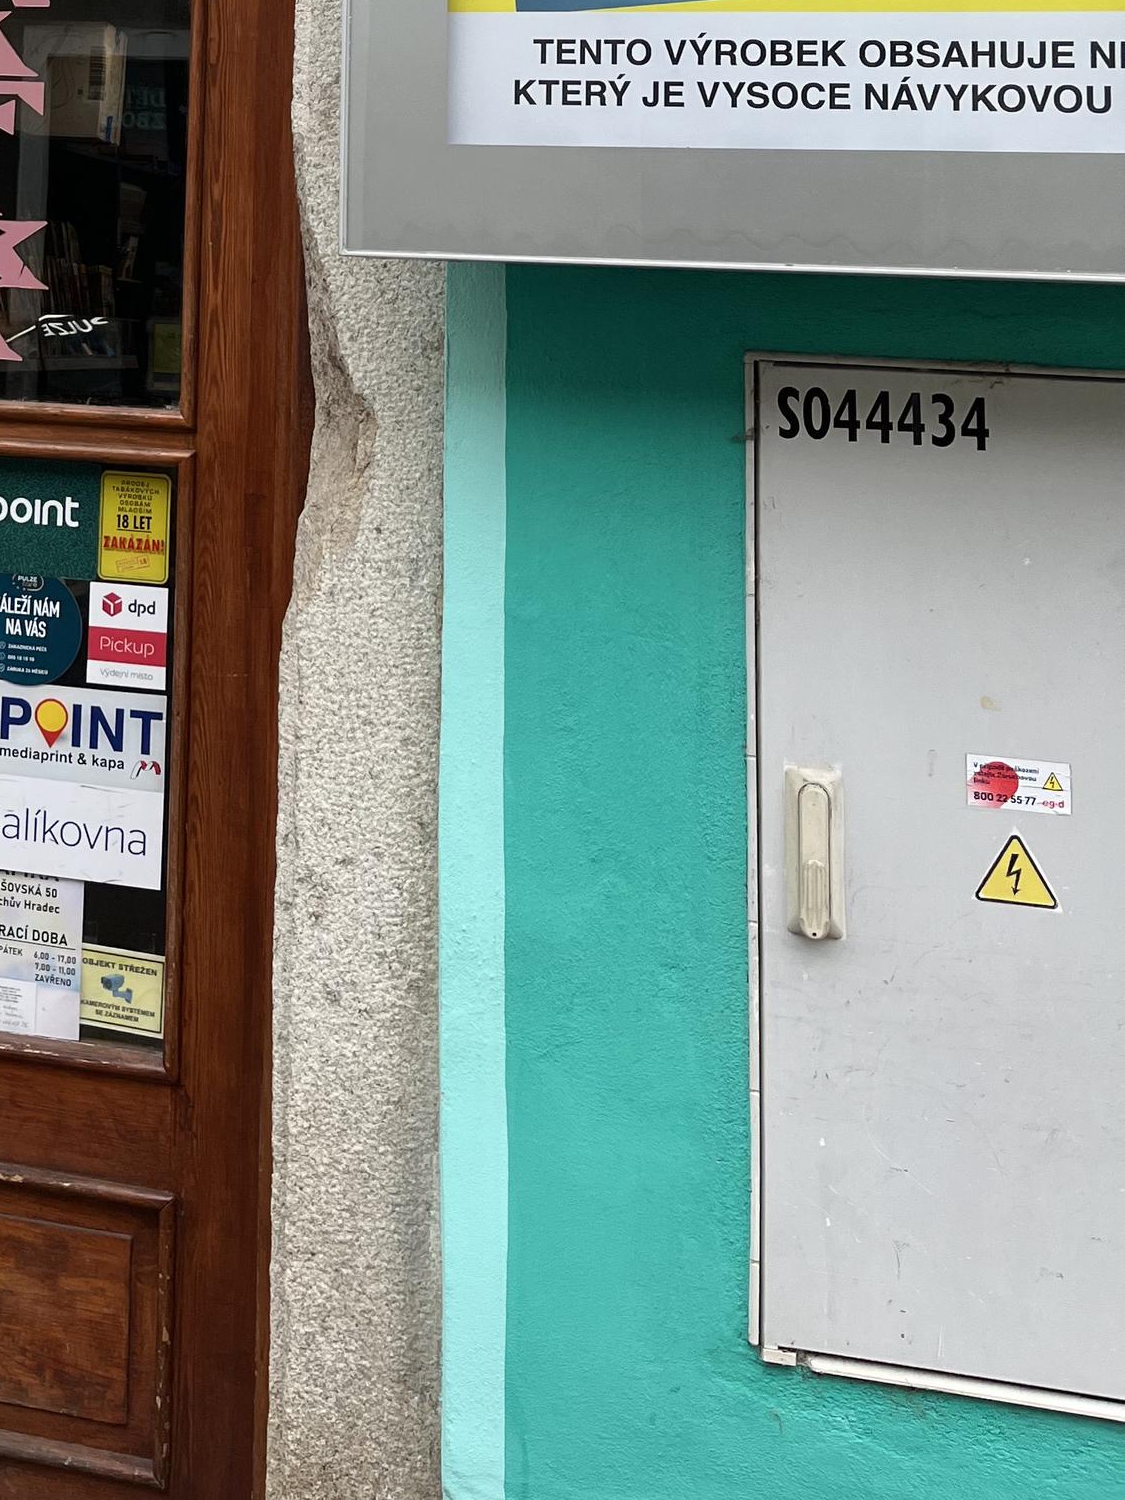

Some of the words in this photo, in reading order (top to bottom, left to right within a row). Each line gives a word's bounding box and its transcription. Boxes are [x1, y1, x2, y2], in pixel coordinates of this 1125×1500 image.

[533, 38, 652, 66] TENTO
[664, 32, 845, 68] VÝROBEK
[858, 39, 1075, 69] OBSAHUJE
[512, 74, 631, 107] KTERÝ
[642, 81, 683, 108] JE
[696, 81, 852, 110] VYSOCE
[864, 76, 1112, 113] NÁVYKOVOU
[777, 386, 990, 451] SO44434
[116, 514, 129, 529] 18
[133, 515, 152, 530] LET
[103, 533, 165, 555] ZAKÁZÁN!
[33, 597, 60, 618] NÁM
[128, 599, 156, 617] dpd
[5, 618, 22, 636] NA
[25, 617, 47, 638] VÁS
[99, 636, 155, 656] Pickup
[99, 667, 130, 682] Výdejní
[132, 669, 154, 681] místo
[0, 696, 164, 756] POINT
[0, 746, 73, 766] mediaprint
[77, 753, 87, 765] &
[91, 754, 125, 771] kapa
[973, 791, 994, 801] 800
[996, 793, 1008, 803] 22
[1011, 795, 1023, 804] 55
[1025, 796, 1036, 806] 77
[45, 887, 58, 899] 50
[24, 899, 60, 915] Hradec
[32, 929, 68, 947] DOBA
[33, 952, 49, 963] 6,00
[58, 955, 76, 966] 17,00
[34, 962, 50, 973] 7,00
[82, 957, 116, 971] OBJEKT
[118, 961, 158, 978] STŘEŽEN
[34, 972, 72, 987] ZAVŘENO
